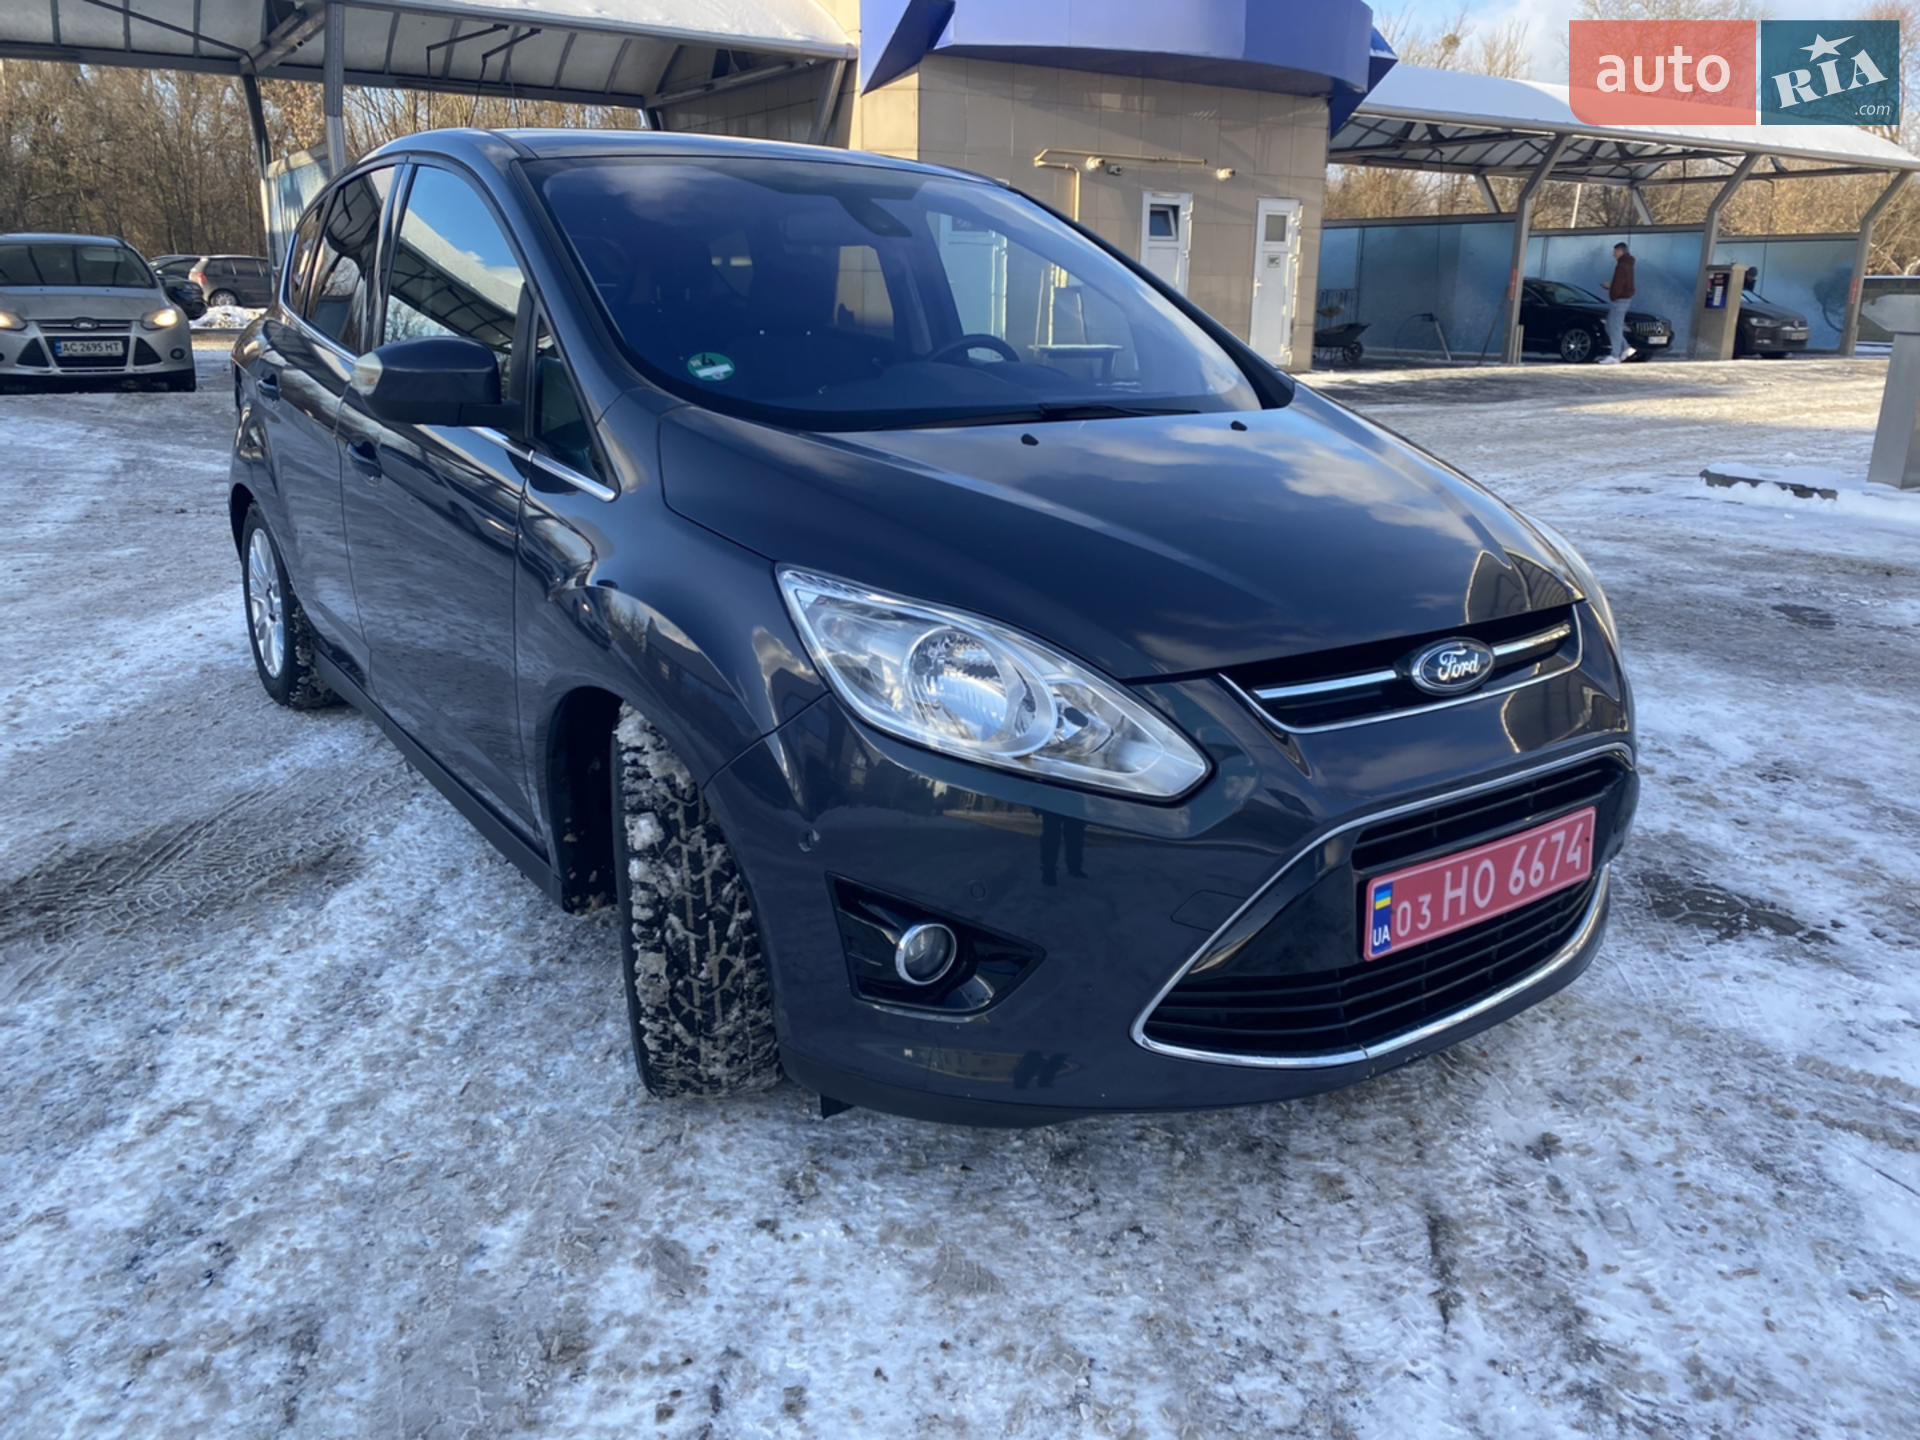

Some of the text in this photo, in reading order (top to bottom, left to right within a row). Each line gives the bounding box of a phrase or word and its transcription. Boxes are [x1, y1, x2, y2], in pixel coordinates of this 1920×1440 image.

[63, 342, 78, 352] AC
[80, 342, 103, 352] 2695
[105, 342, 119, 352] HT
[1437, 648, 1481, 683] Ford
[1396, 822, 1584, 938] 03 HO 6674
[1373, 924, 1391, 947] UA
